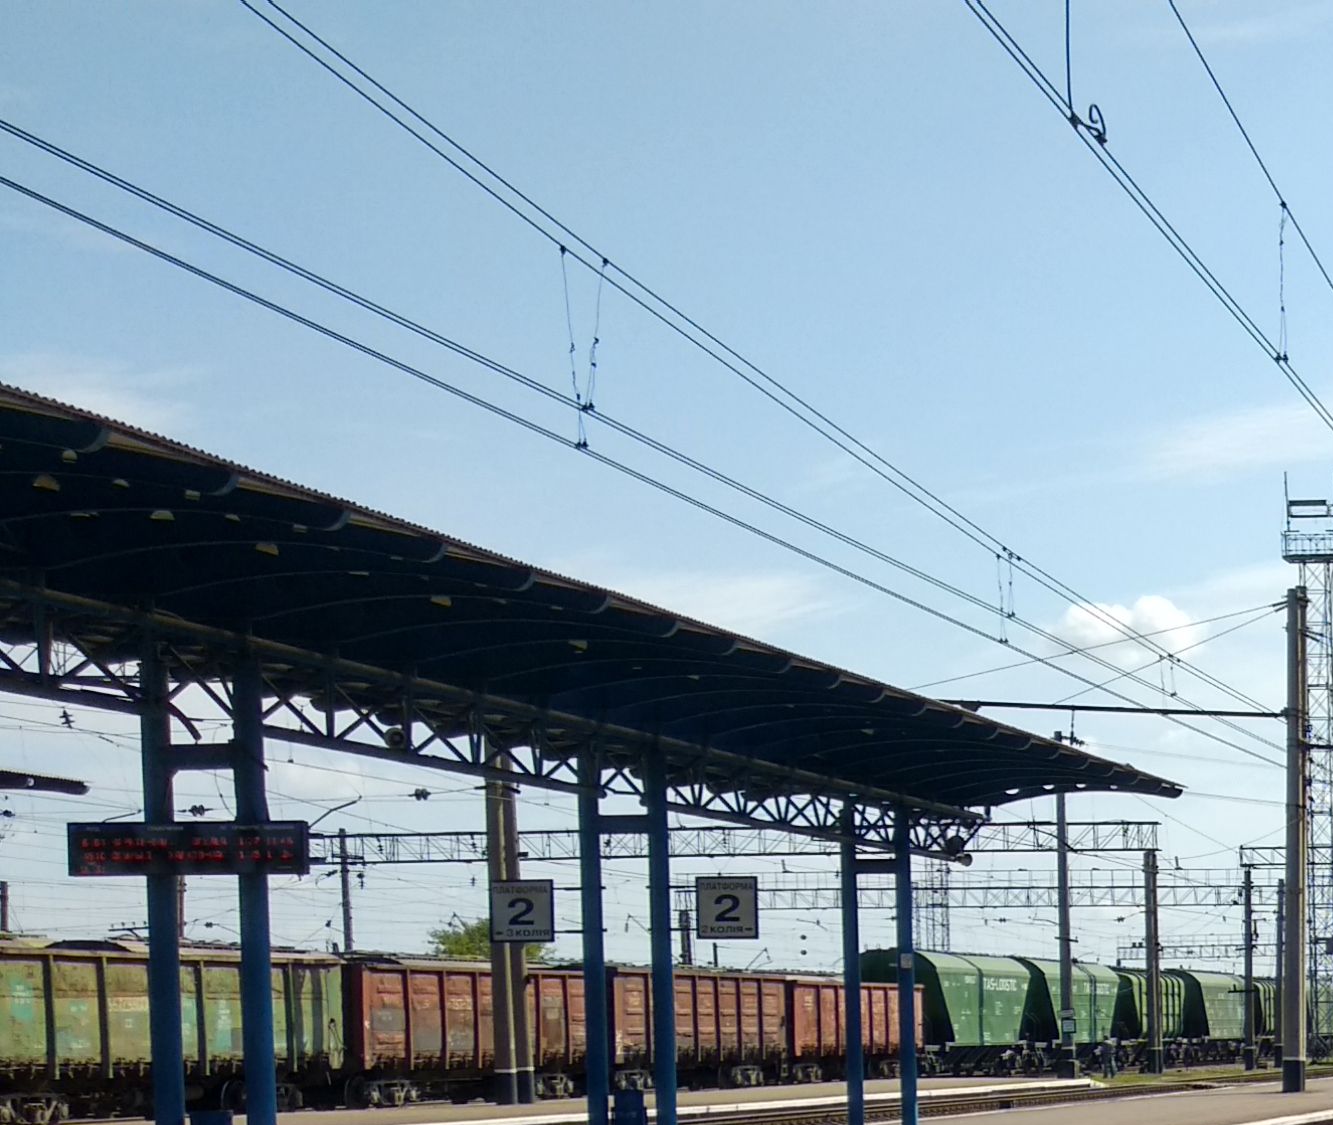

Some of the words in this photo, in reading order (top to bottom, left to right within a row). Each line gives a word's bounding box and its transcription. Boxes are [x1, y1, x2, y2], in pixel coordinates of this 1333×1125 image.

[700, 881, 754, 891] ПЛАТФОРМА
[507, 897, 534, 926] 2
[714, 893, 741, 922] 2
